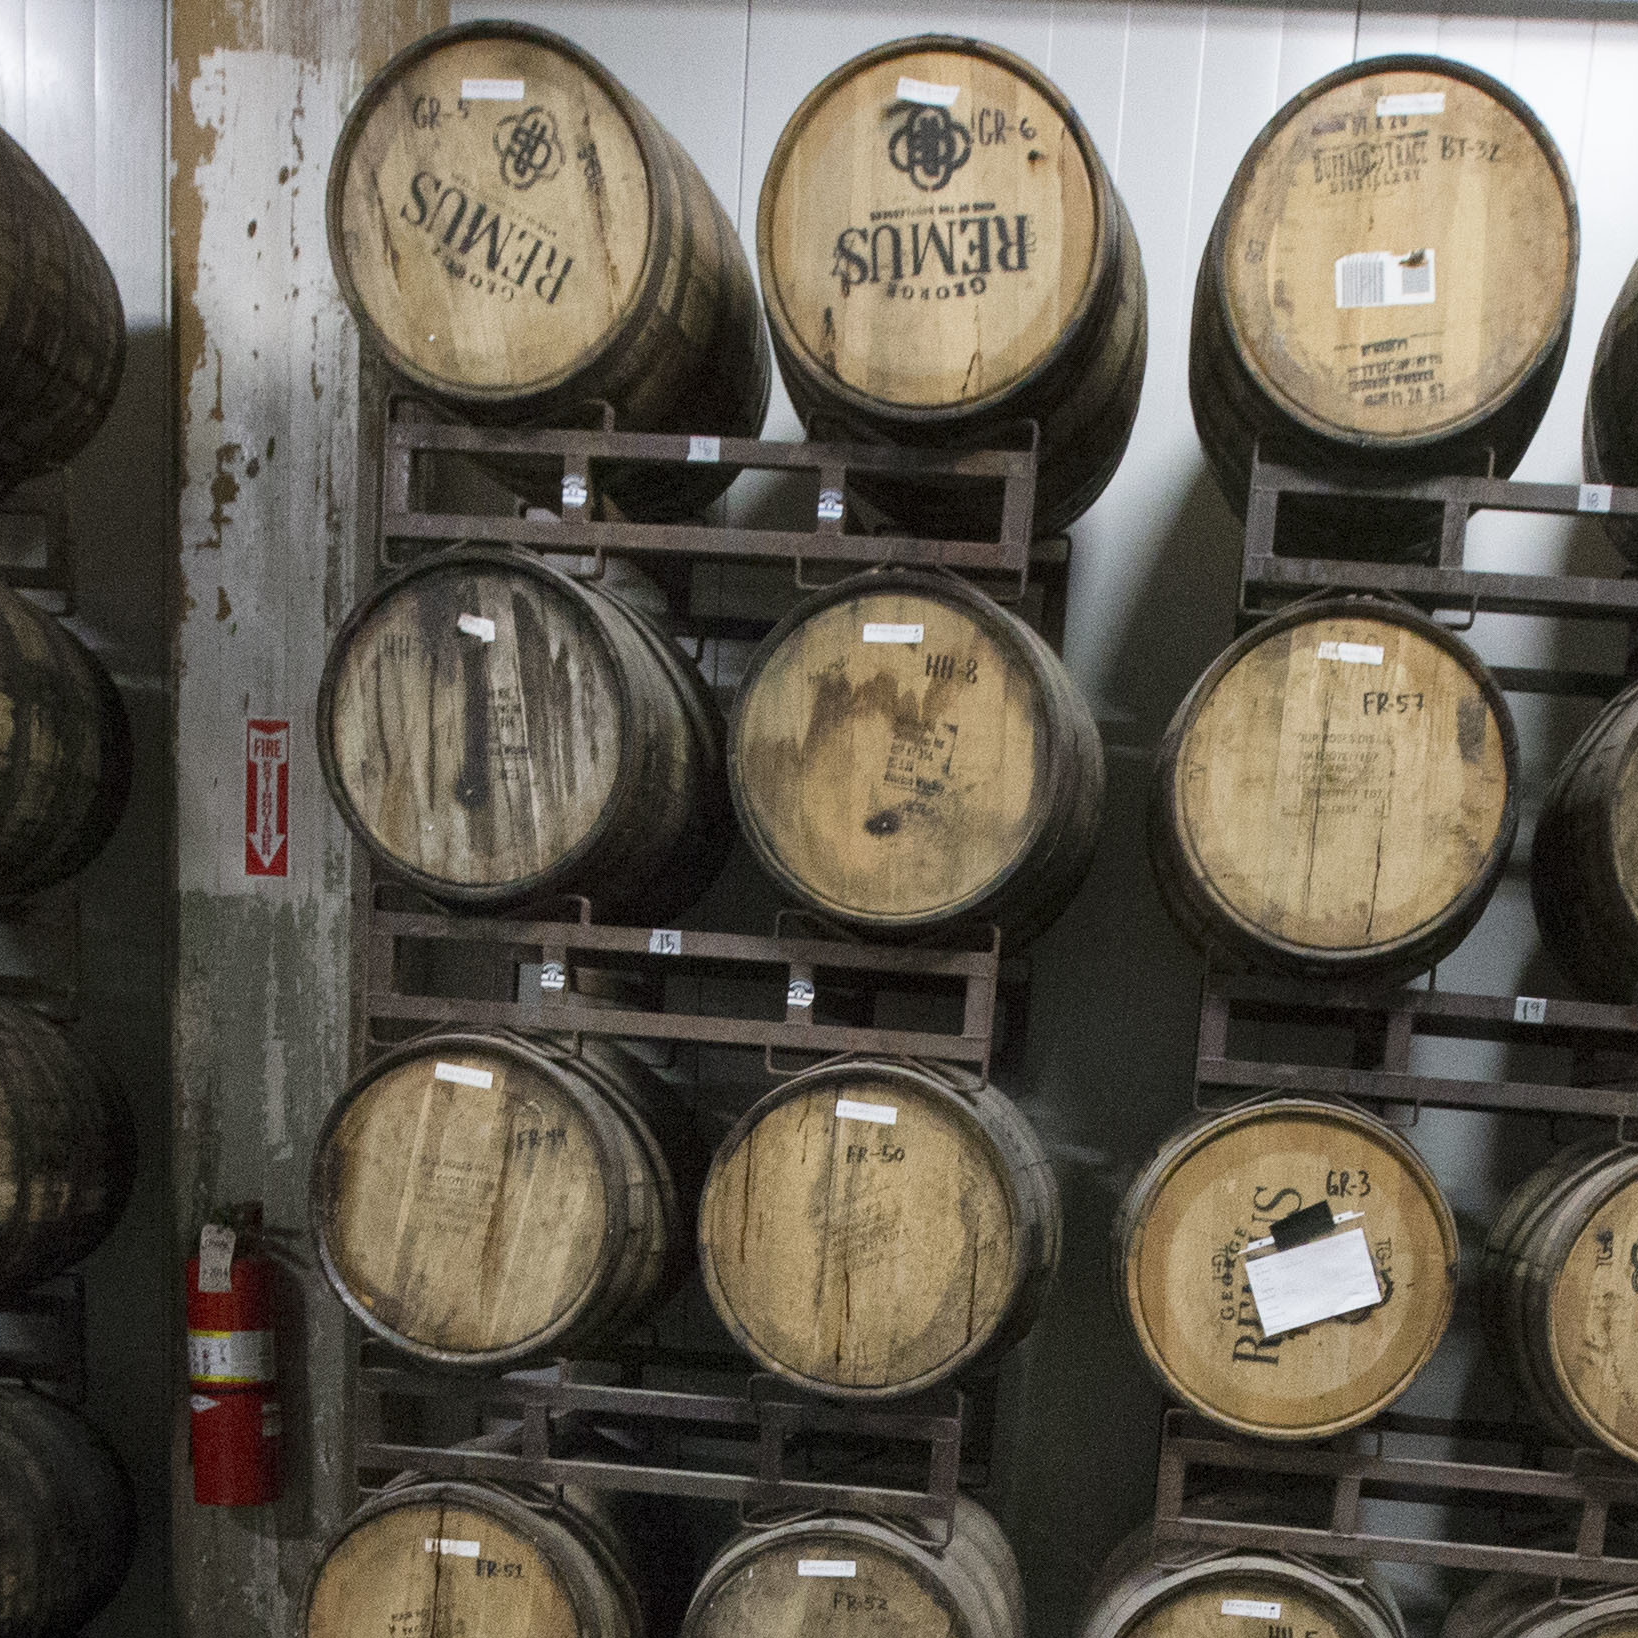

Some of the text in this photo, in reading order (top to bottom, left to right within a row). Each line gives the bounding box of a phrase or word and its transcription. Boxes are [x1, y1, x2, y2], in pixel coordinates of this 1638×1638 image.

[977, 108, 1038, 148] GR-6
[401, 170, 574, 305] REMUS
[837, 214, 1029, 285] REMUS
[885, 276, 987, 302] GEORGE
[925, 652, 979, 685] HH-8
[1362, 691, 1424, 717] FR-57
[253, 737, 283, 759] FIRE
[1521, 1000, 1541, 1021] 19
[845, 1144, 906, 1165] FR-50
[1326, 1169, 1372, 1199] GR-3
[1222, 1225, 1248, 1322] GEORGE
[475, 1559, 525, 1579] FR-51
[831, 1590, 890, 1614] FR-52
